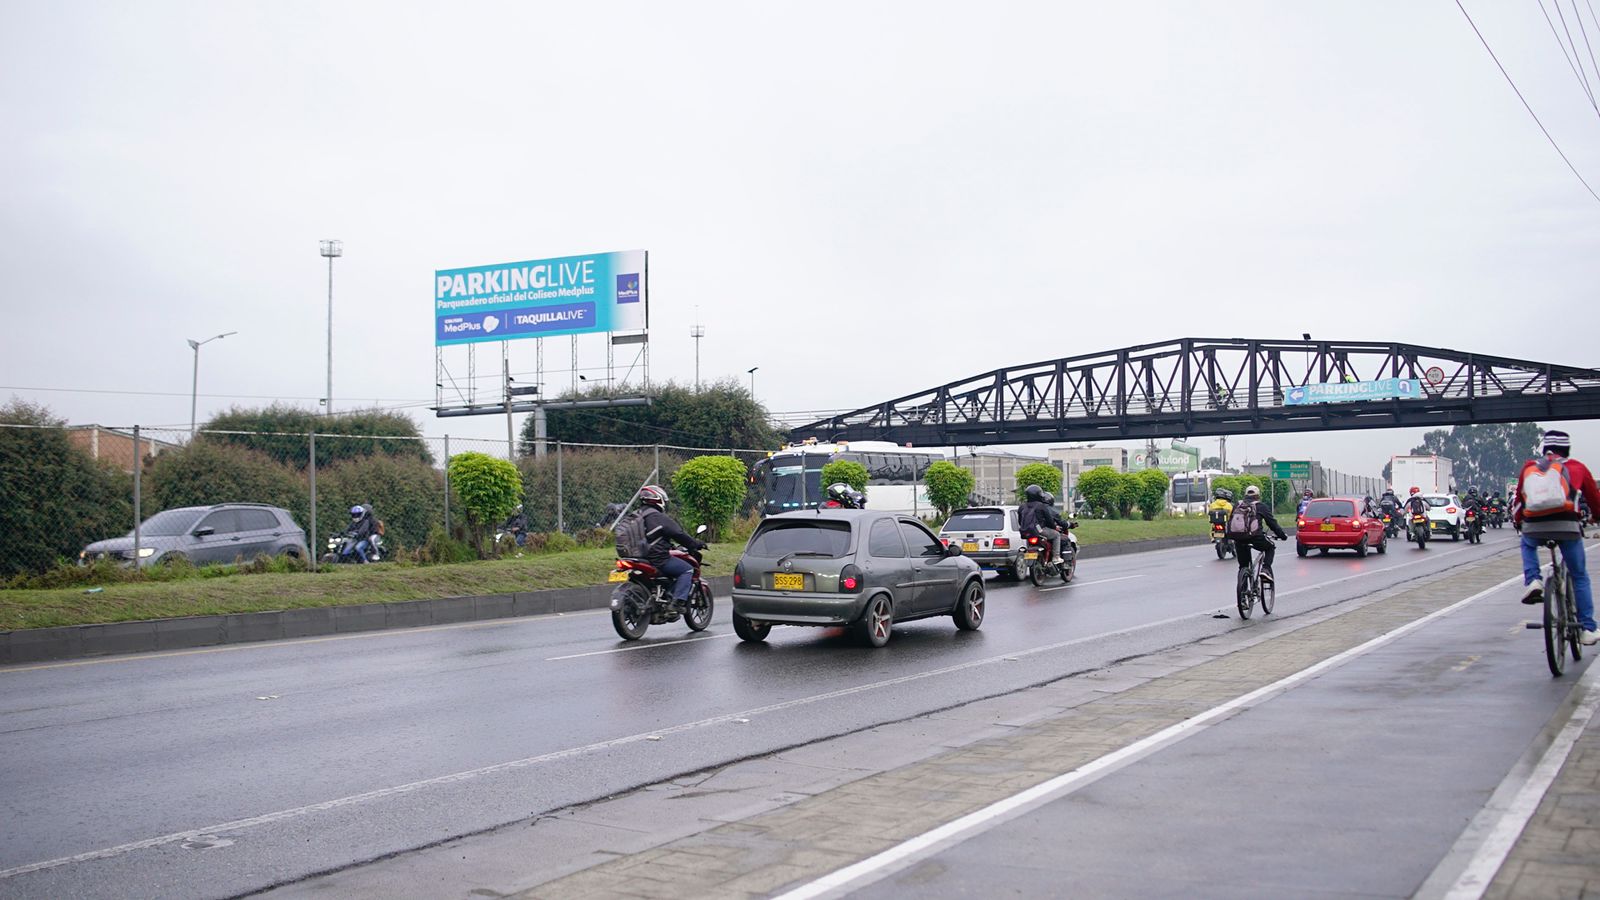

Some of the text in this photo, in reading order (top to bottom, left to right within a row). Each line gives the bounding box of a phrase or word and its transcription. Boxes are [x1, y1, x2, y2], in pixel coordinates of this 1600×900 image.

[437, 261, 595, 297] PARKINGLIVE
[437, 286, 594, 310] Parqueadero oficial del Coliseo Medplus
[444, 322, 481, 333] MedPlus
[1309, 380, 1392, 395] PARKINGLIVE
